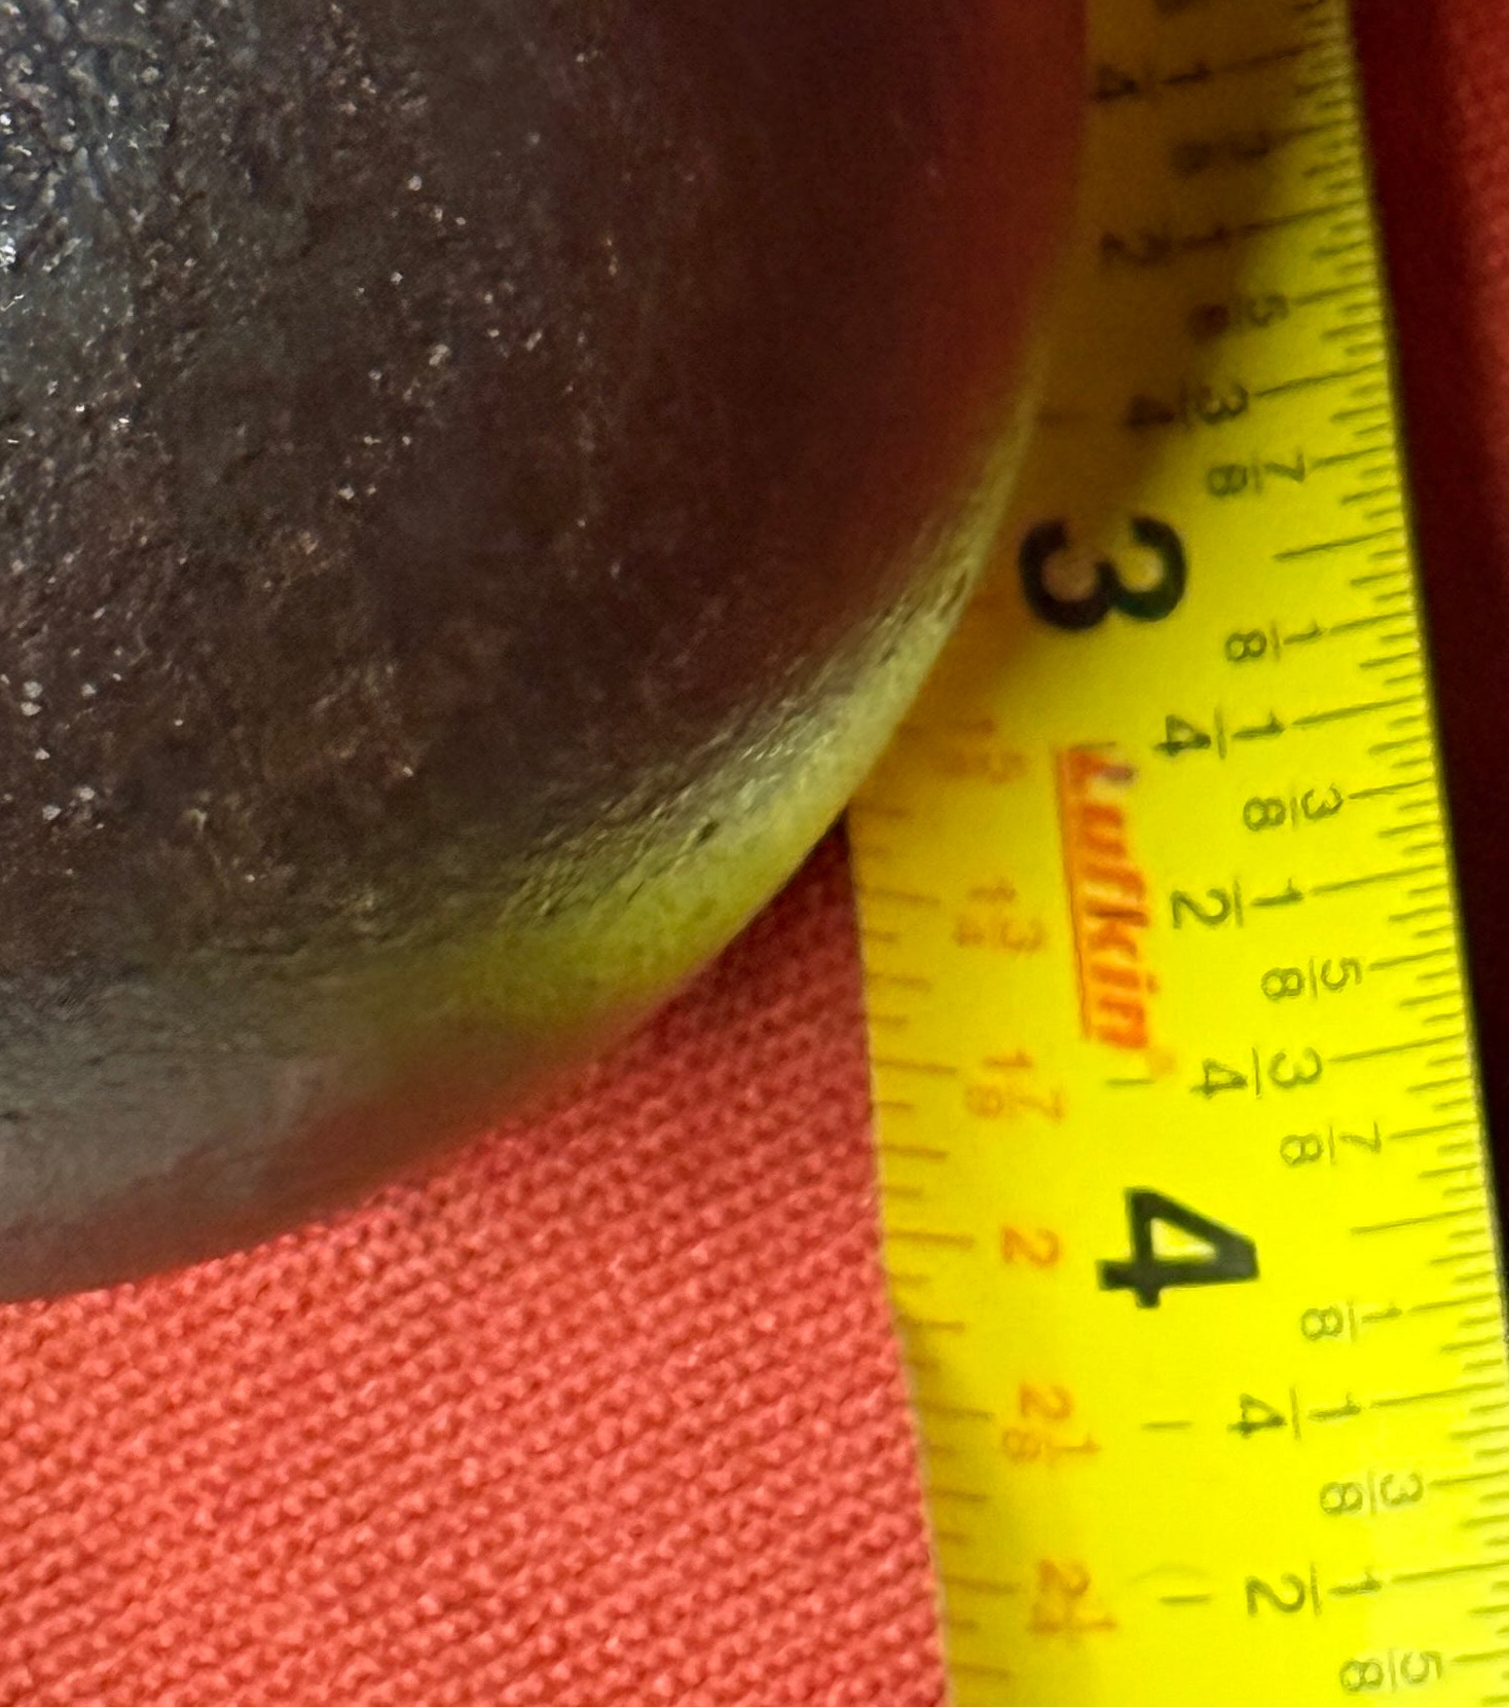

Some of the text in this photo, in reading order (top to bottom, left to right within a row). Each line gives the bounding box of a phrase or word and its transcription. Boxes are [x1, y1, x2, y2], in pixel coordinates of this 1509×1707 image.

[1018, 514, 1188, 632] 3
[1062, 747, 1160, 1050] Lufkin
[1096, 1185, 1260, 1310] 4
